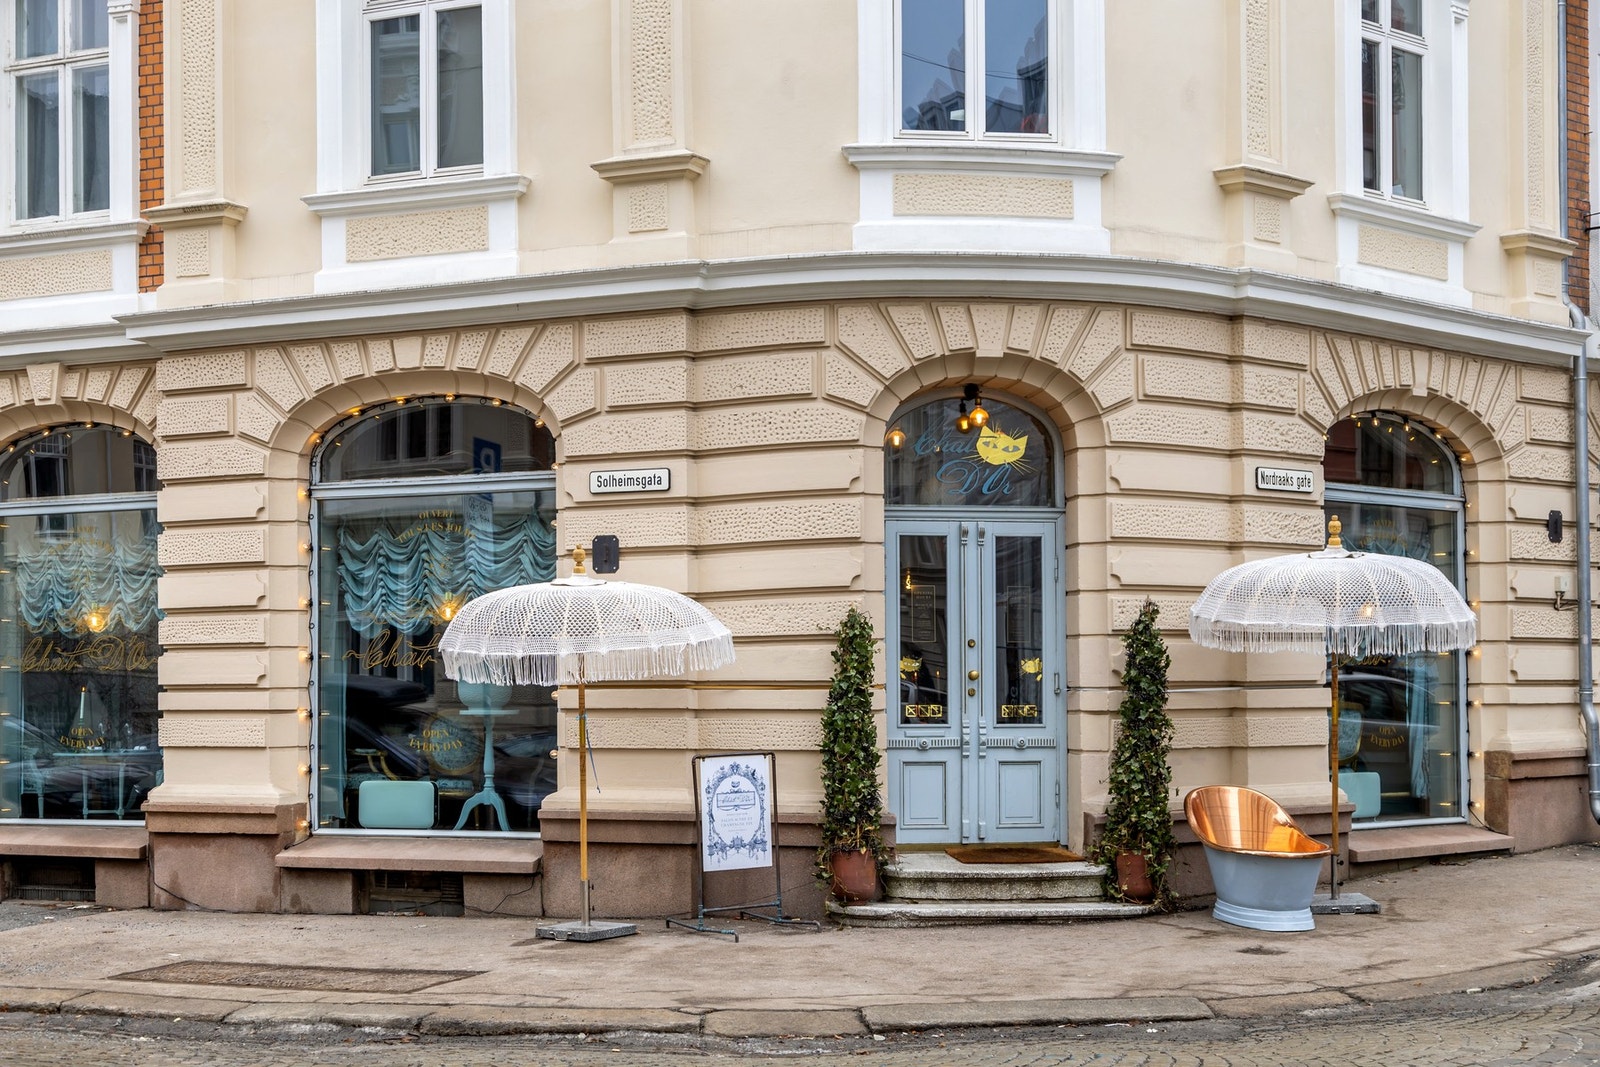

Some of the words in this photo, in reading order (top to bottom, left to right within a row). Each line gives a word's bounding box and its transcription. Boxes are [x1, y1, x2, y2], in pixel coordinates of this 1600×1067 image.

[596, 473, 662, 490] Solheimsgata
[1260, 470, 1294, 487] Nordraaks
[1296, 475, 1312, 490] gate
[71, 727, 94, 737] OPEN
[422, 729, 449, 738] OPEN
